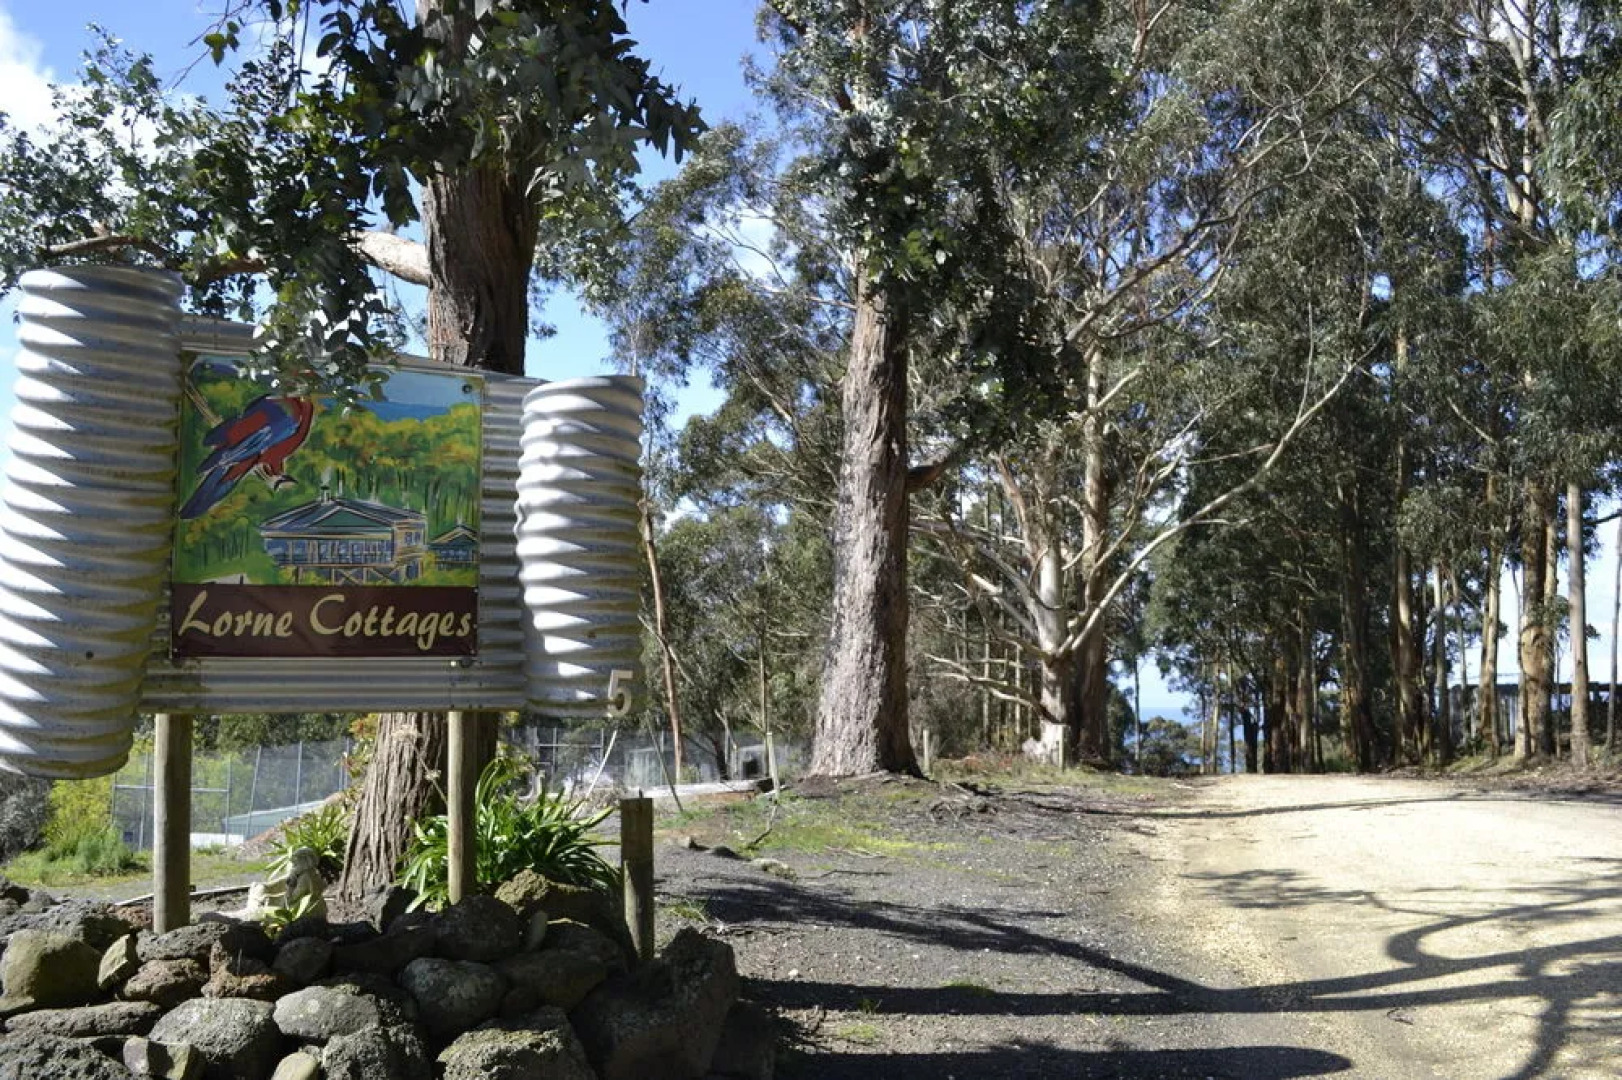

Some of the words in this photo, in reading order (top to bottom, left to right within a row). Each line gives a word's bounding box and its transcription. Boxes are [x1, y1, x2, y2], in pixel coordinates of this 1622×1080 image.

[178, 590, 293, 637] Lorne
[309, 594, 472, 650] Cottages
[607, 669, 634, 718] 5
